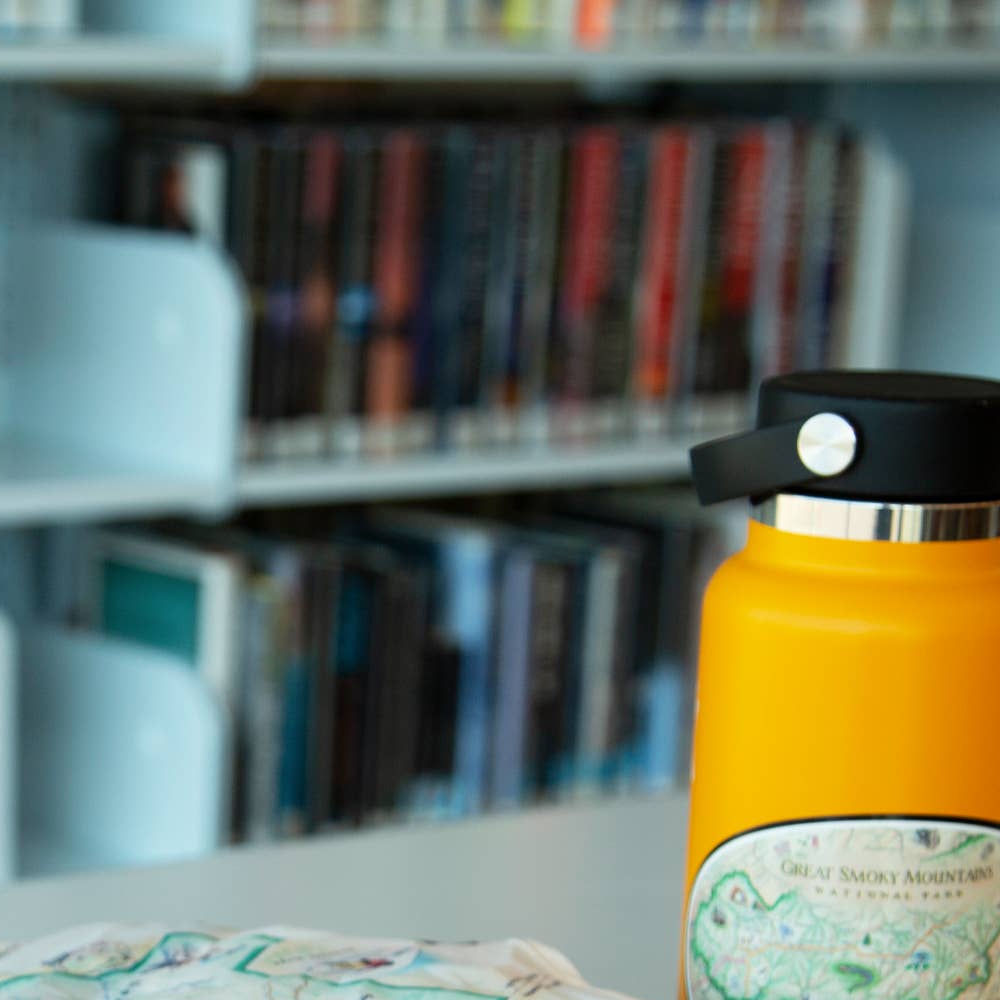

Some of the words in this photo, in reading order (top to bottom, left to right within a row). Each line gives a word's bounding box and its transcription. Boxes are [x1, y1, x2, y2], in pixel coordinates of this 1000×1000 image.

[781, 860, 832, 880] GREAT
[840, 866, 900, 885] SMOKY
[904, 865, 994, 884] MOUNTAINS
